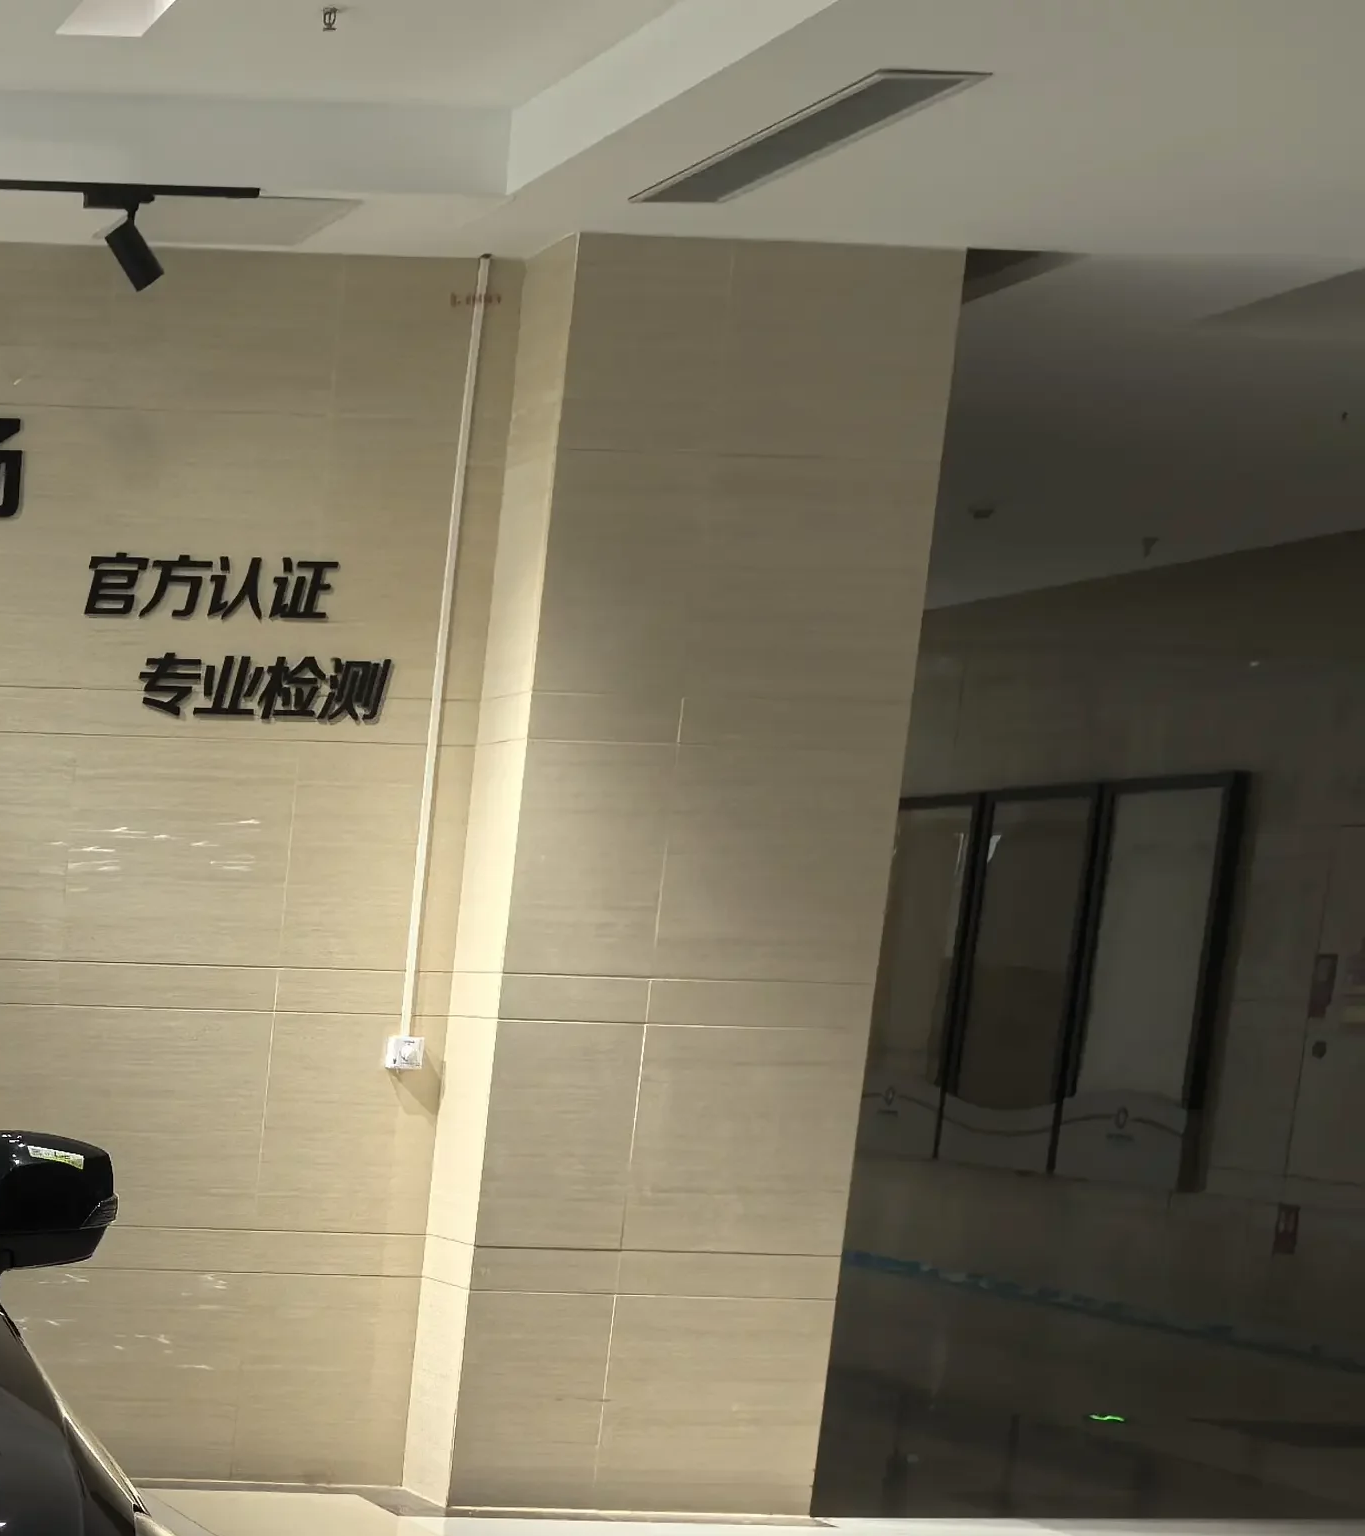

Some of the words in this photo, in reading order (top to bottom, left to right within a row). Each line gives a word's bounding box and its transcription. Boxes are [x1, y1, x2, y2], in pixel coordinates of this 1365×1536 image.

[83, 552, 340, 620] 官方认证
[138, 652, 392, 721] 专业检测
